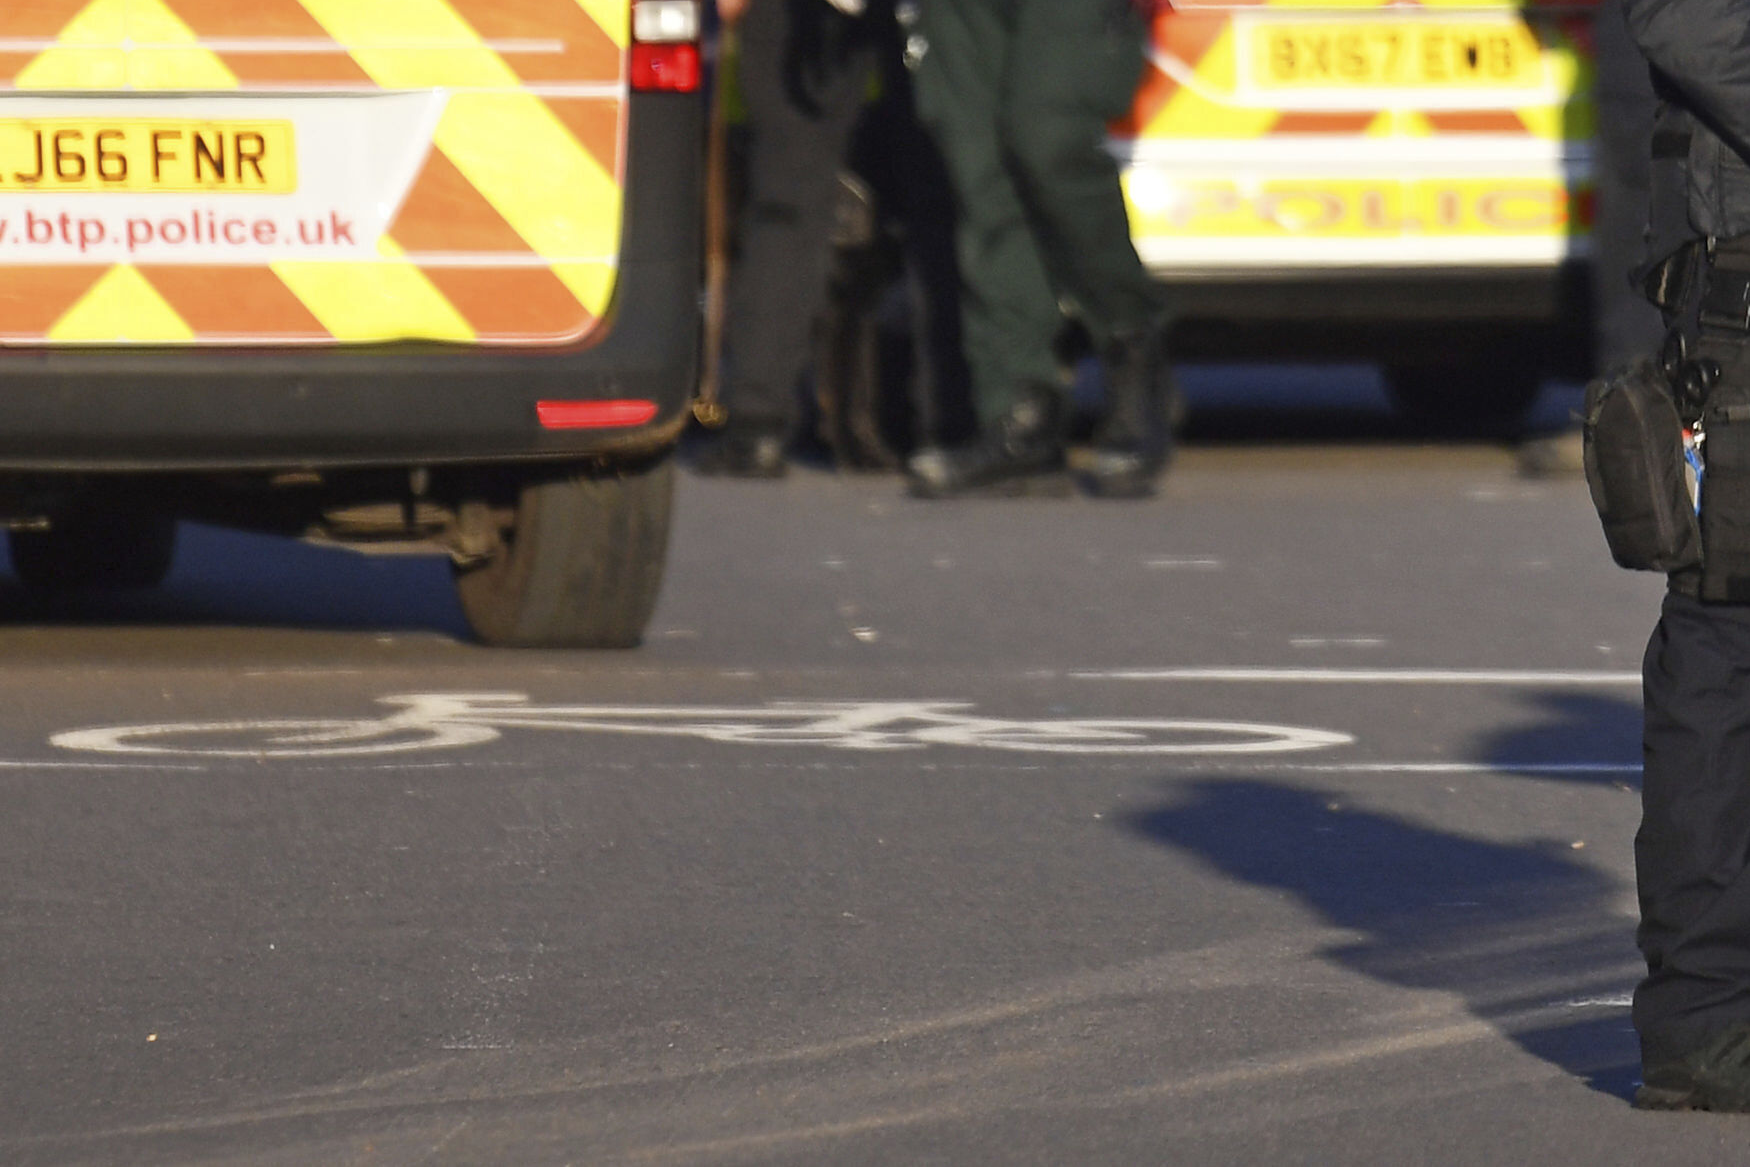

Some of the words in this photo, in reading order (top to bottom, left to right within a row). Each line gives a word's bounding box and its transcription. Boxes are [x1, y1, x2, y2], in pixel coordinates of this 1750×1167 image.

[0, 129, 129, 184] J66
[150, 129, 267, 184] FNR
[0, 209, 356, 252] .btp.police.uk
